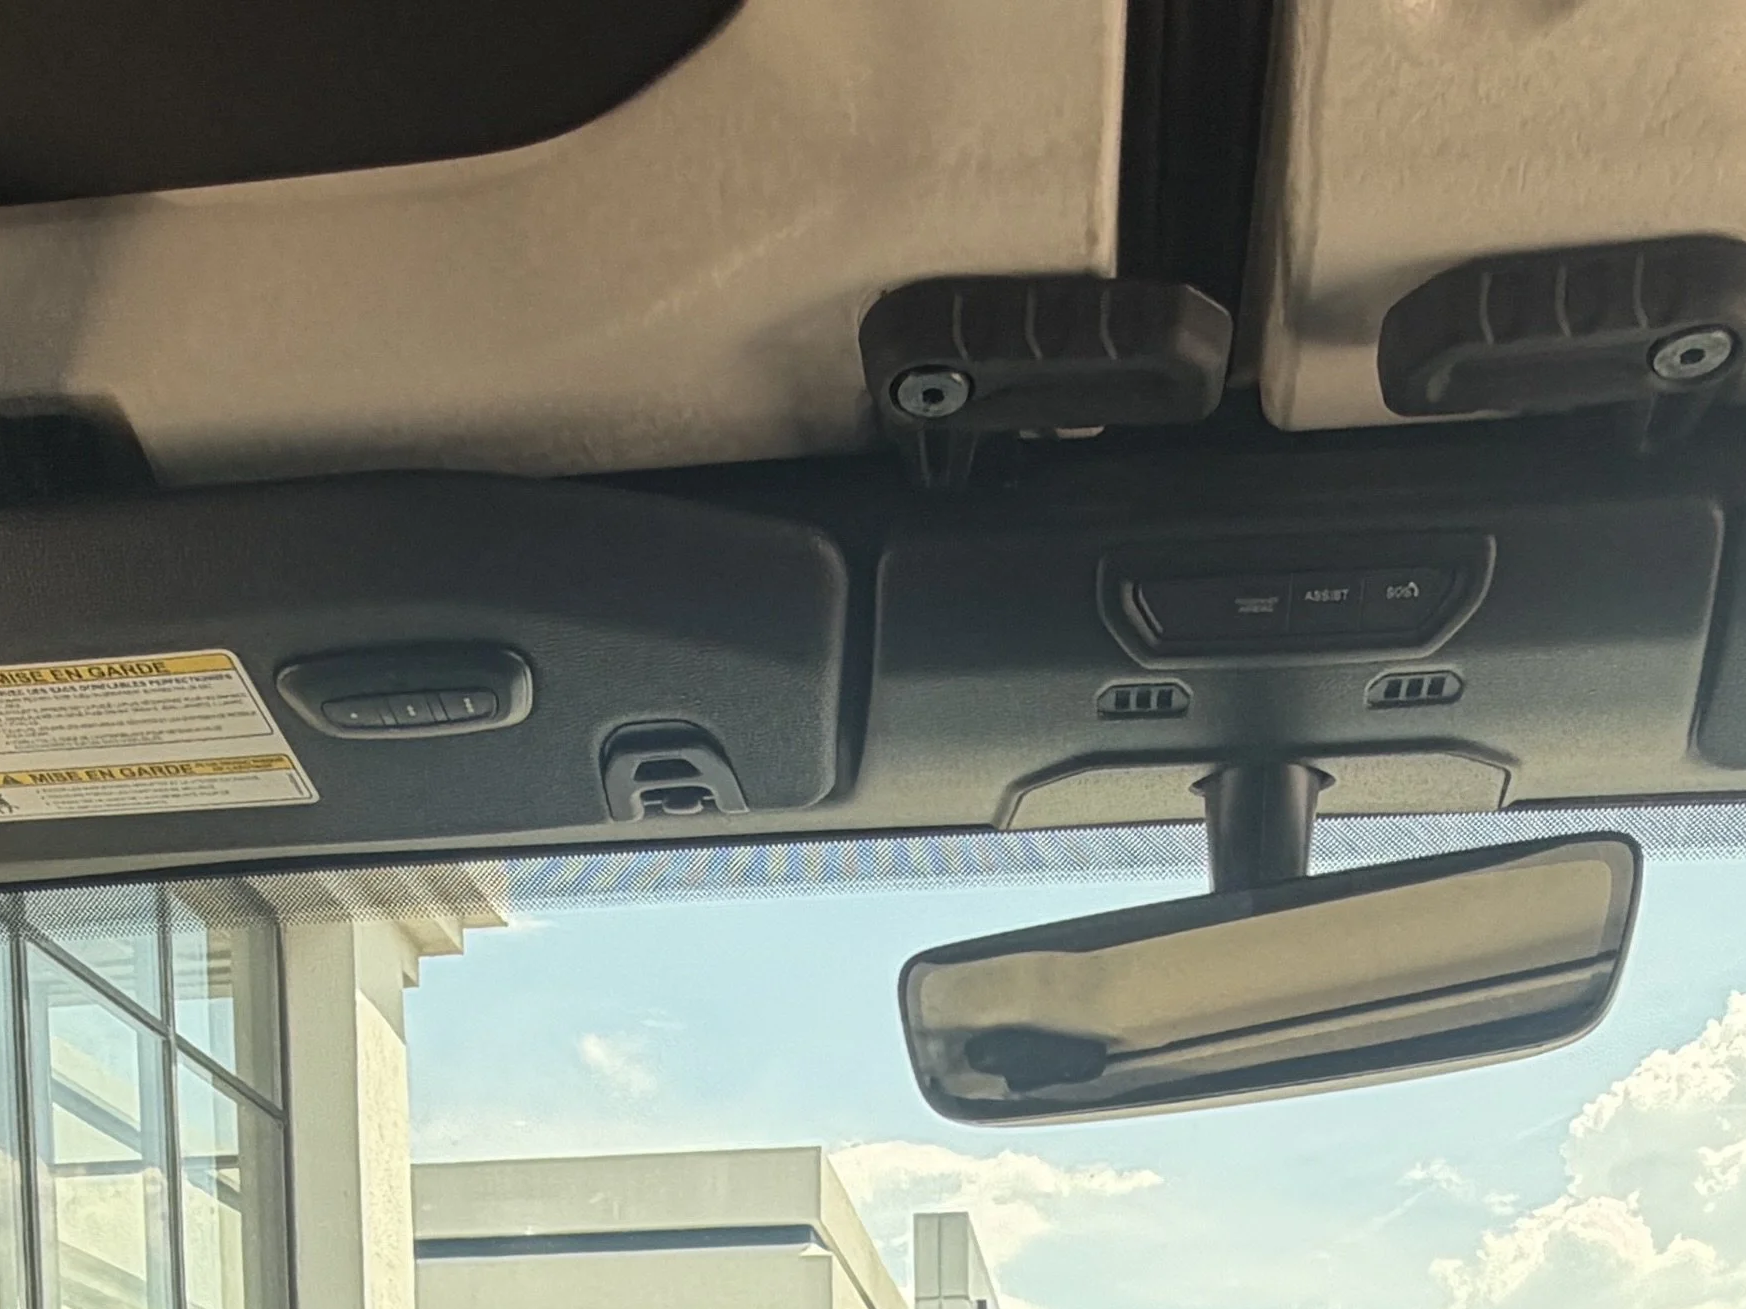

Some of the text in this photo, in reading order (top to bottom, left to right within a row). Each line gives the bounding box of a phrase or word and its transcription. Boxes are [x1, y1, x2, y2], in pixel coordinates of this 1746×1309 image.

[1305, 588, 1350, 602] ASSIST
[1386, 586, 1412, 599] SOS
[53, 665, 82, 682] EN
[86, 661, 170, 680] GARDE
[30, 771, 83, 786] MISE
[86, 768, 113, 783] EN
[119, 763, 194, 780] GARDE
